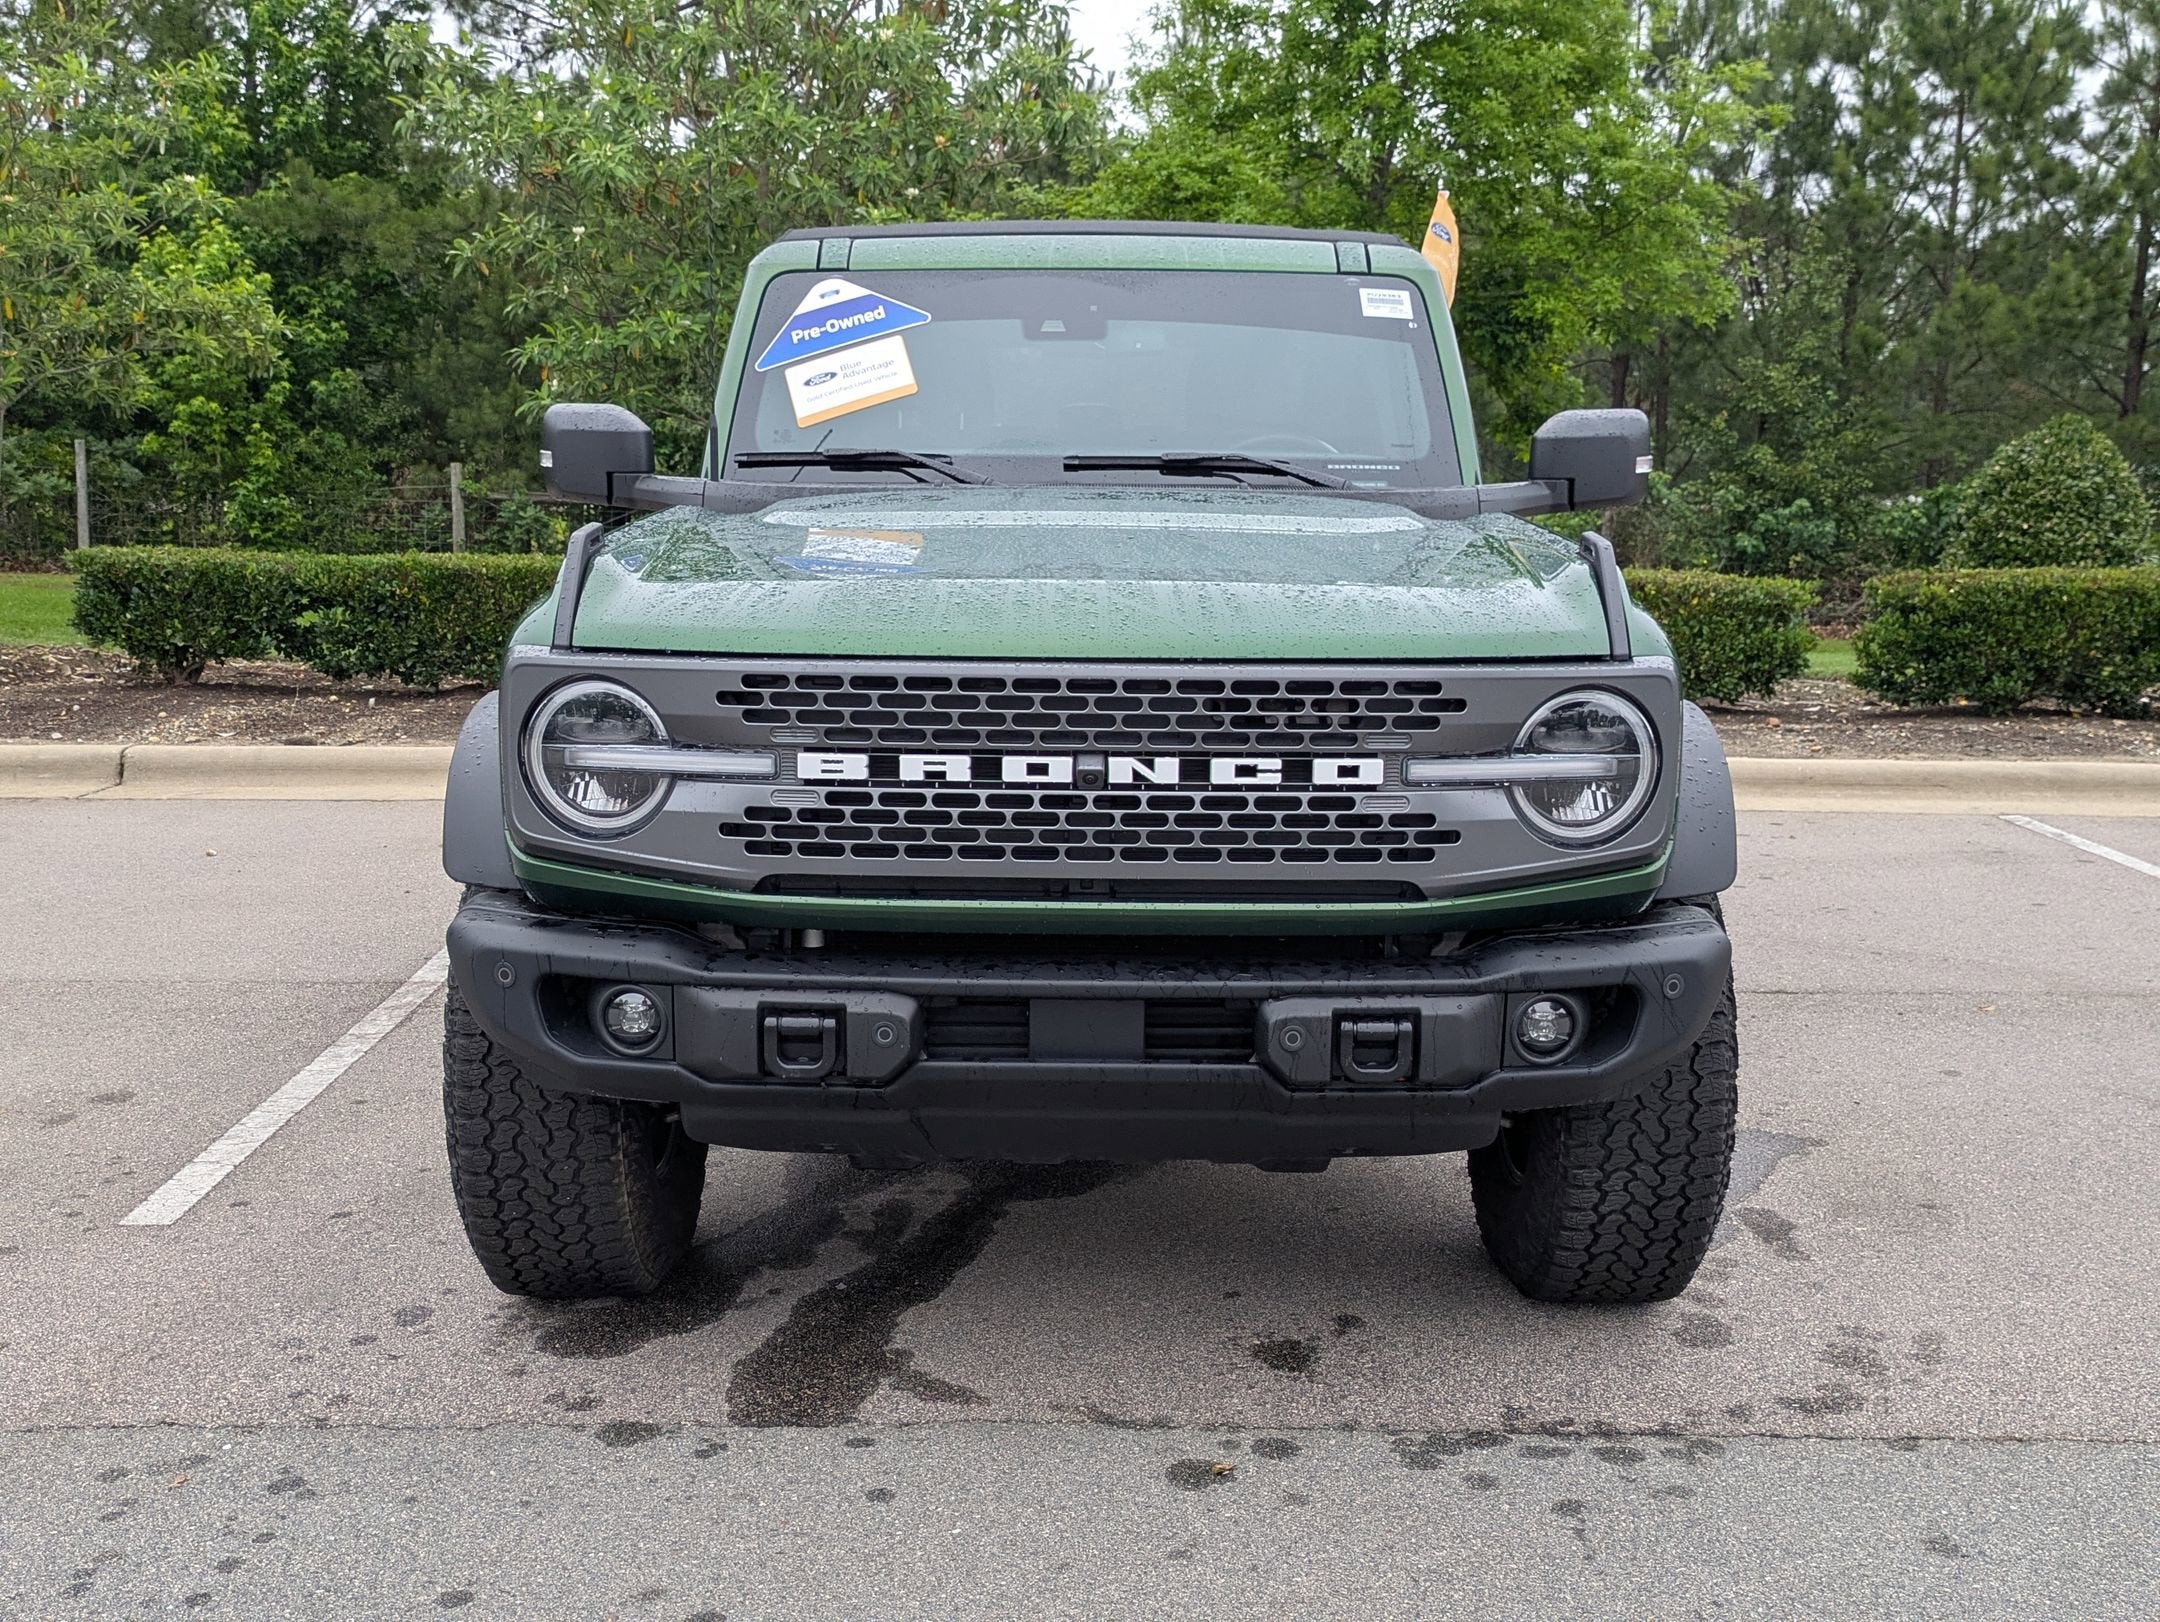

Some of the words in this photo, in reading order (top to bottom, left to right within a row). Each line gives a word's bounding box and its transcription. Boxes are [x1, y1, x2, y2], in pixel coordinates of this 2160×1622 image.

[1432, 223, 1450, 240] Ford
[790, 305, 887, 344] Pre-Owned
[840, 360, 862, 372] Blue
[842, 359, 895, 379] Advantage
[807, 372, 834, 387] Ford
[798, 752, 1384, 784] BRONCO
